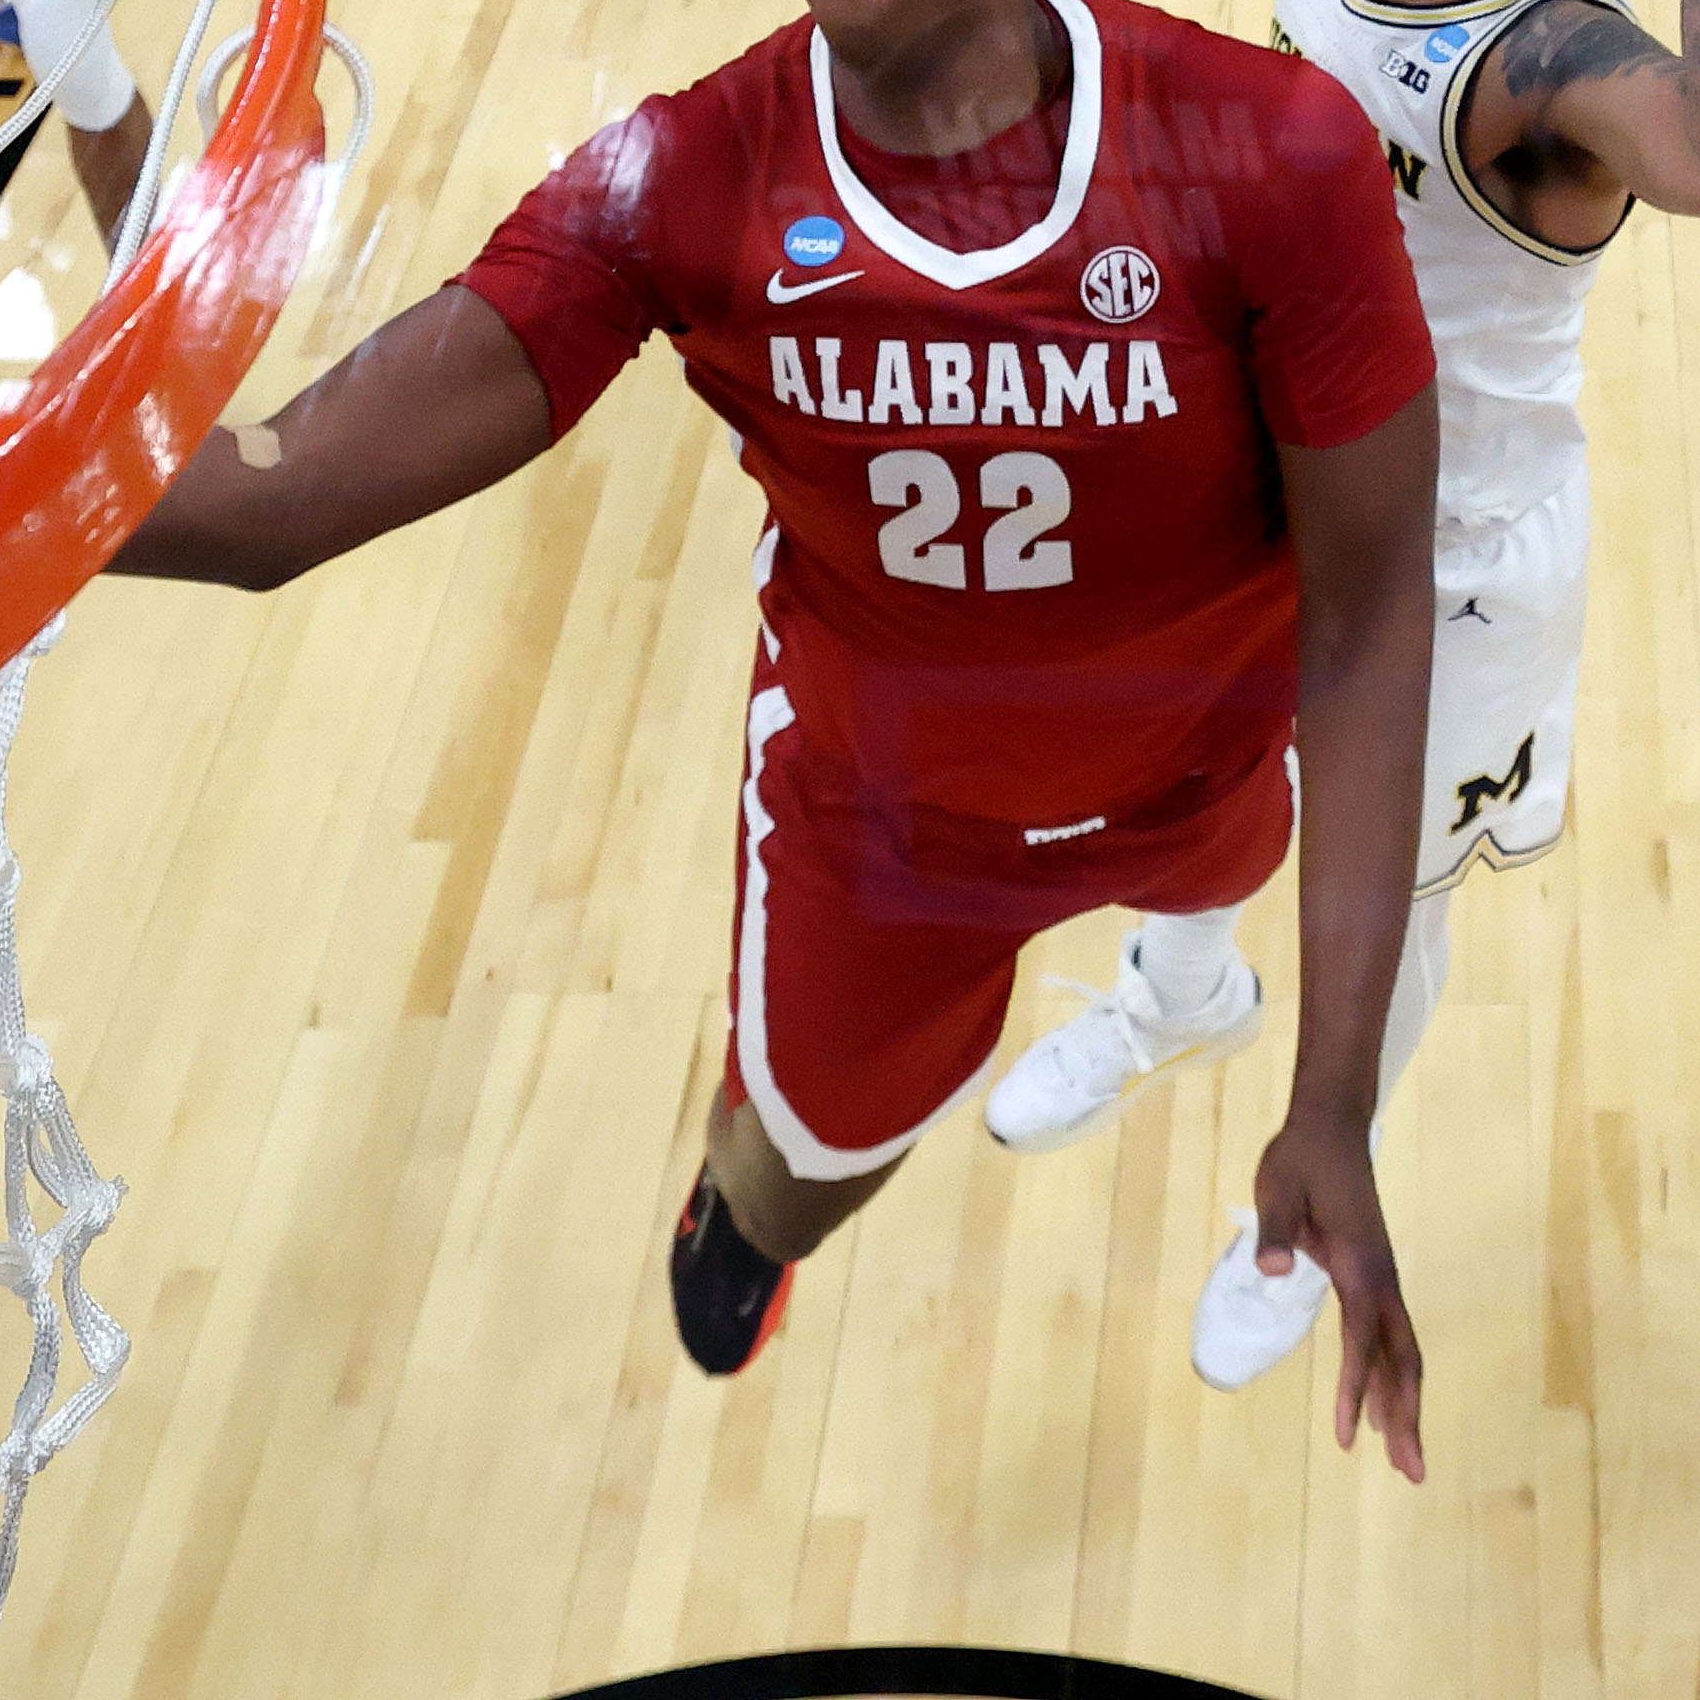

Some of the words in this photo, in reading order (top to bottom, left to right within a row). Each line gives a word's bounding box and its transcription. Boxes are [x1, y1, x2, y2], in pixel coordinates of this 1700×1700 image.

[790, 236, 839, 255] NCAA
[1086, 250, 1154, 319] SEC
[769, 335, 1178, 427] ALABAMA
[868, 449, 1074, 592] 22
